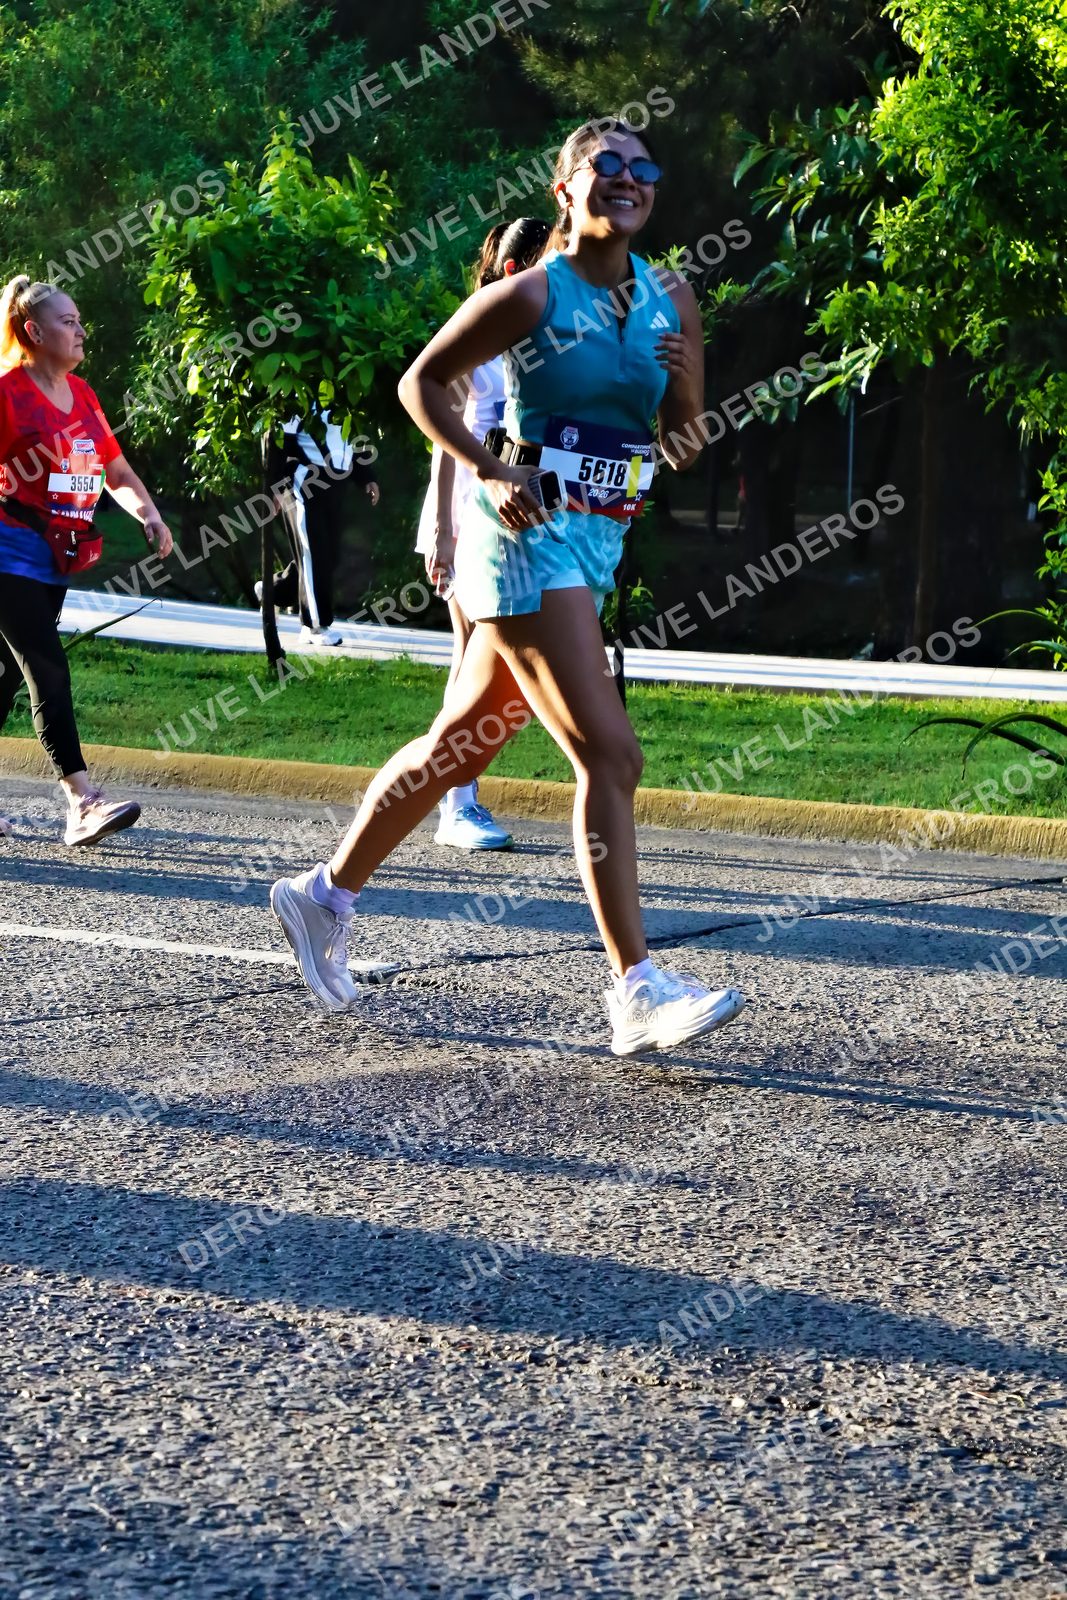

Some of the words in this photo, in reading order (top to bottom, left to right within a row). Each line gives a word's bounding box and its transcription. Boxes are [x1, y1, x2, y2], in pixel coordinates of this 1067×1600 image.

[578, 456, 627, 487] 5618
[70, 475, 94, 492] 3554
[623, 503, 637, 511] 10K
